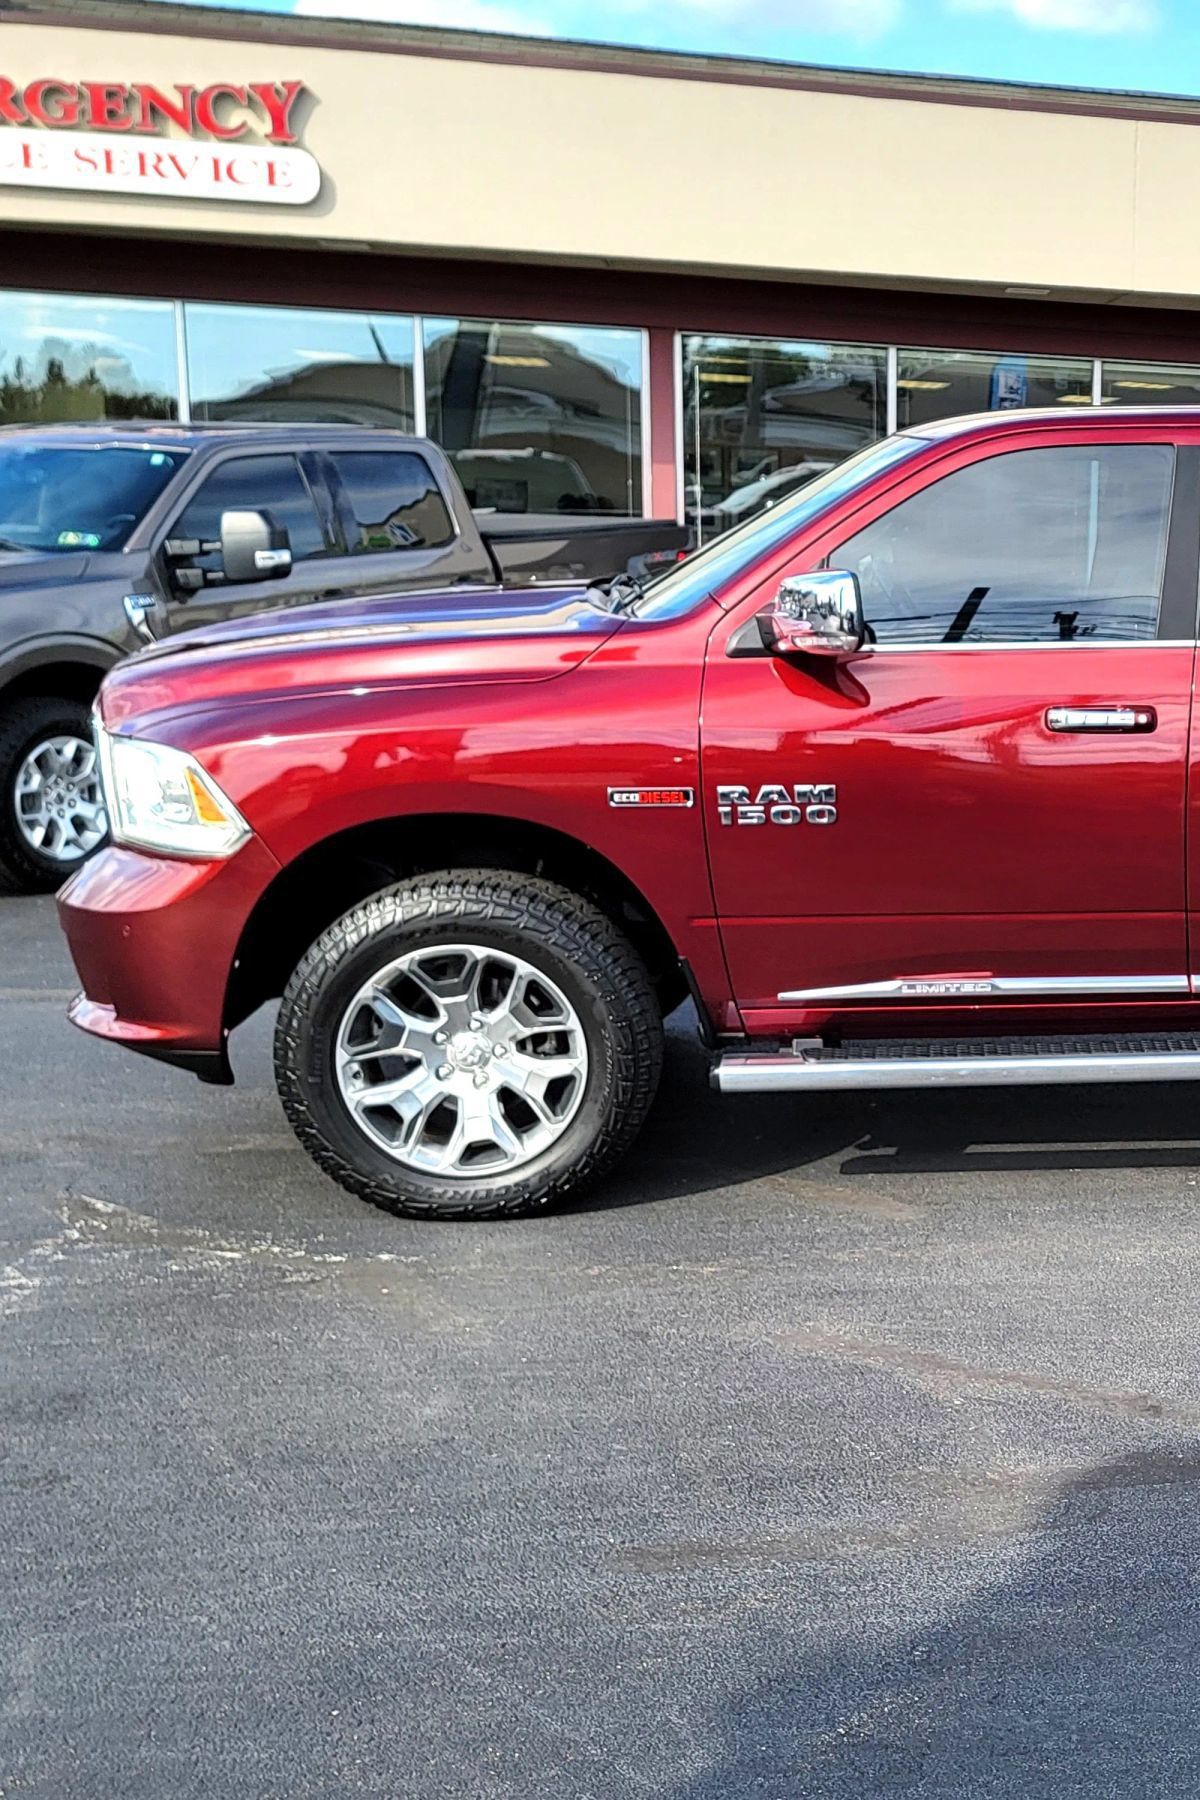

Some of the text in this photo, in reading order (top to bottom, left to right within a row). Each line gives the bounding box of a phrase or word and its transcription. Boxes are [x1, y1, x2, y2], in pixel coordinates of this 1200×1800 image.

[0, 76, 302, 143] RGENCY
[74, 147, 293, 189] SERVICE
[613, 791, 687, 804] ECODIESEL
[716, 784, 837, 804] RAM
[717, 805, 837, 825] 1500
[901, 983, 991, 993] LIMITED
